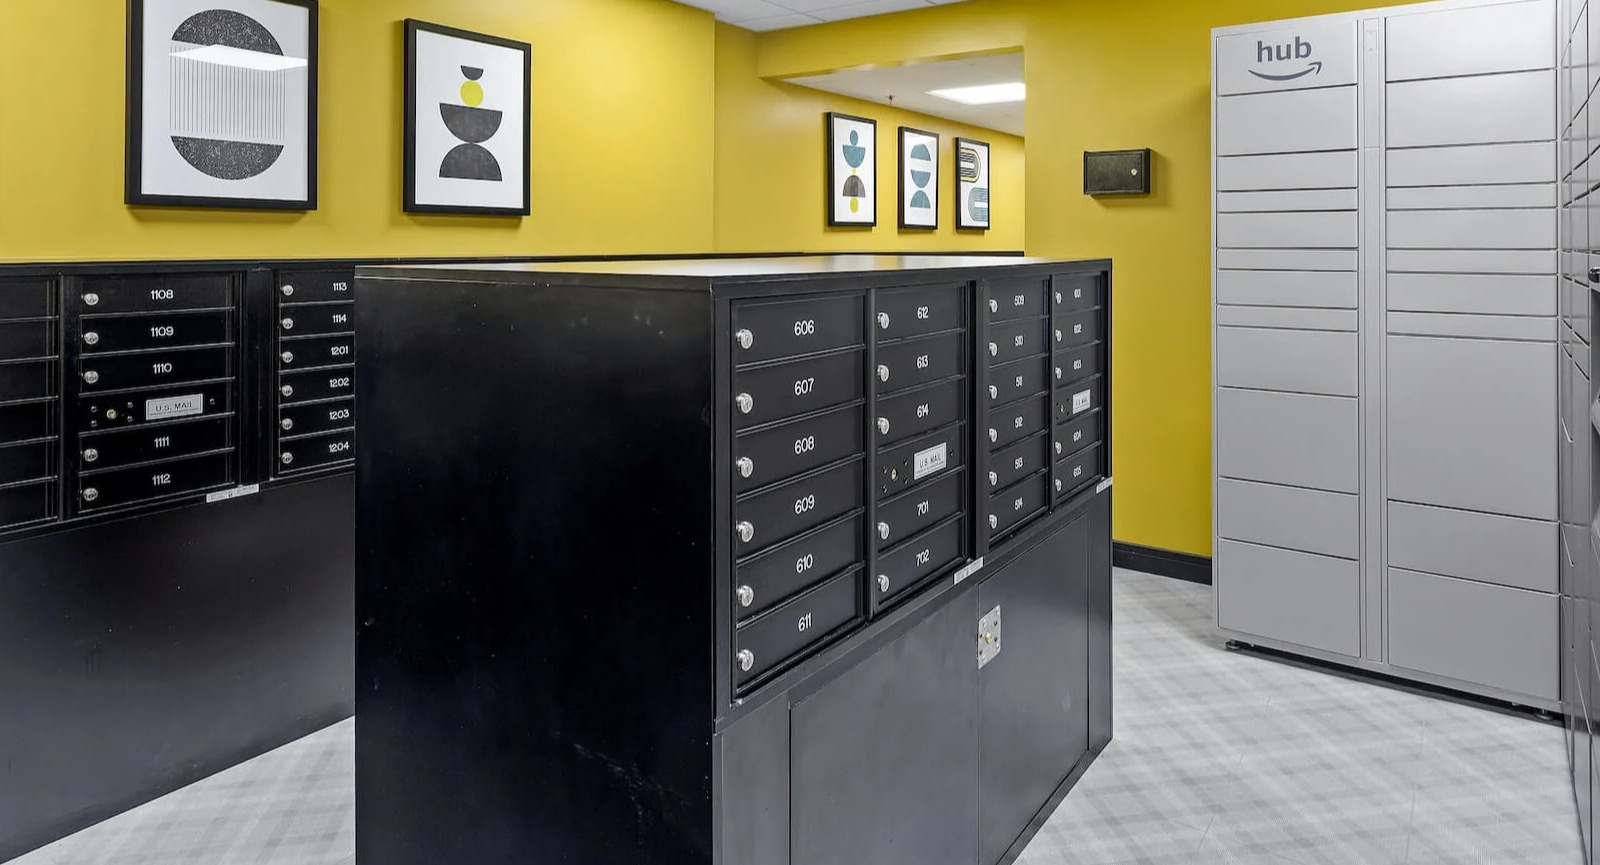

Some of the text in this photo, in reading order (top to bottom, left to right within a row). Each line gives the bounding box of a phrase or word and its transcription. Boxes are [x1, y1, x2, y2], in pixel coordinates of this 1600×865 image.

[1257, 36, 1312, 63] hub
[333, 282, 347, 291] 1113
[151, 290, 173, 299] 1108
[1014, 295, 1025, 305] 509
[333, 314, 346, 323] 1114
[918, 307, 929, 318] 612
[151, 326, 173, 337] 1109
[794, 320, 815, 335] 606
[1015, 336, 1024, 346] 510
[331, 346, 348, 355] 1201
[916, 355, 929, 368] 613
[153, 363, 172, 374] 1110
[330, 378, 349, 387] 1202
[795, 378, 814, 395] 607
[155, 404, 171, 412] U.S.
[174, 401, 192, 410] MAIL
[916, 404, 929, 417] 614
[330, 409, 349, 419] 1203
[1014, 416, 1023, 428] 512
[154, 436, 170, 448] 1111
[329, 441, 349, 452] 1204
[795, 436, 814, 454] 608
[1014, 457, 1024, 469] 513
[152, 473, 171, 485] 1112
[794, 495, 814, 514] 609
[917, 500, 929, 516] 701
[796, 554, 813, 573] 610
[916, 549, 930, 566] 702
[798, 613, 812, 631] 611
